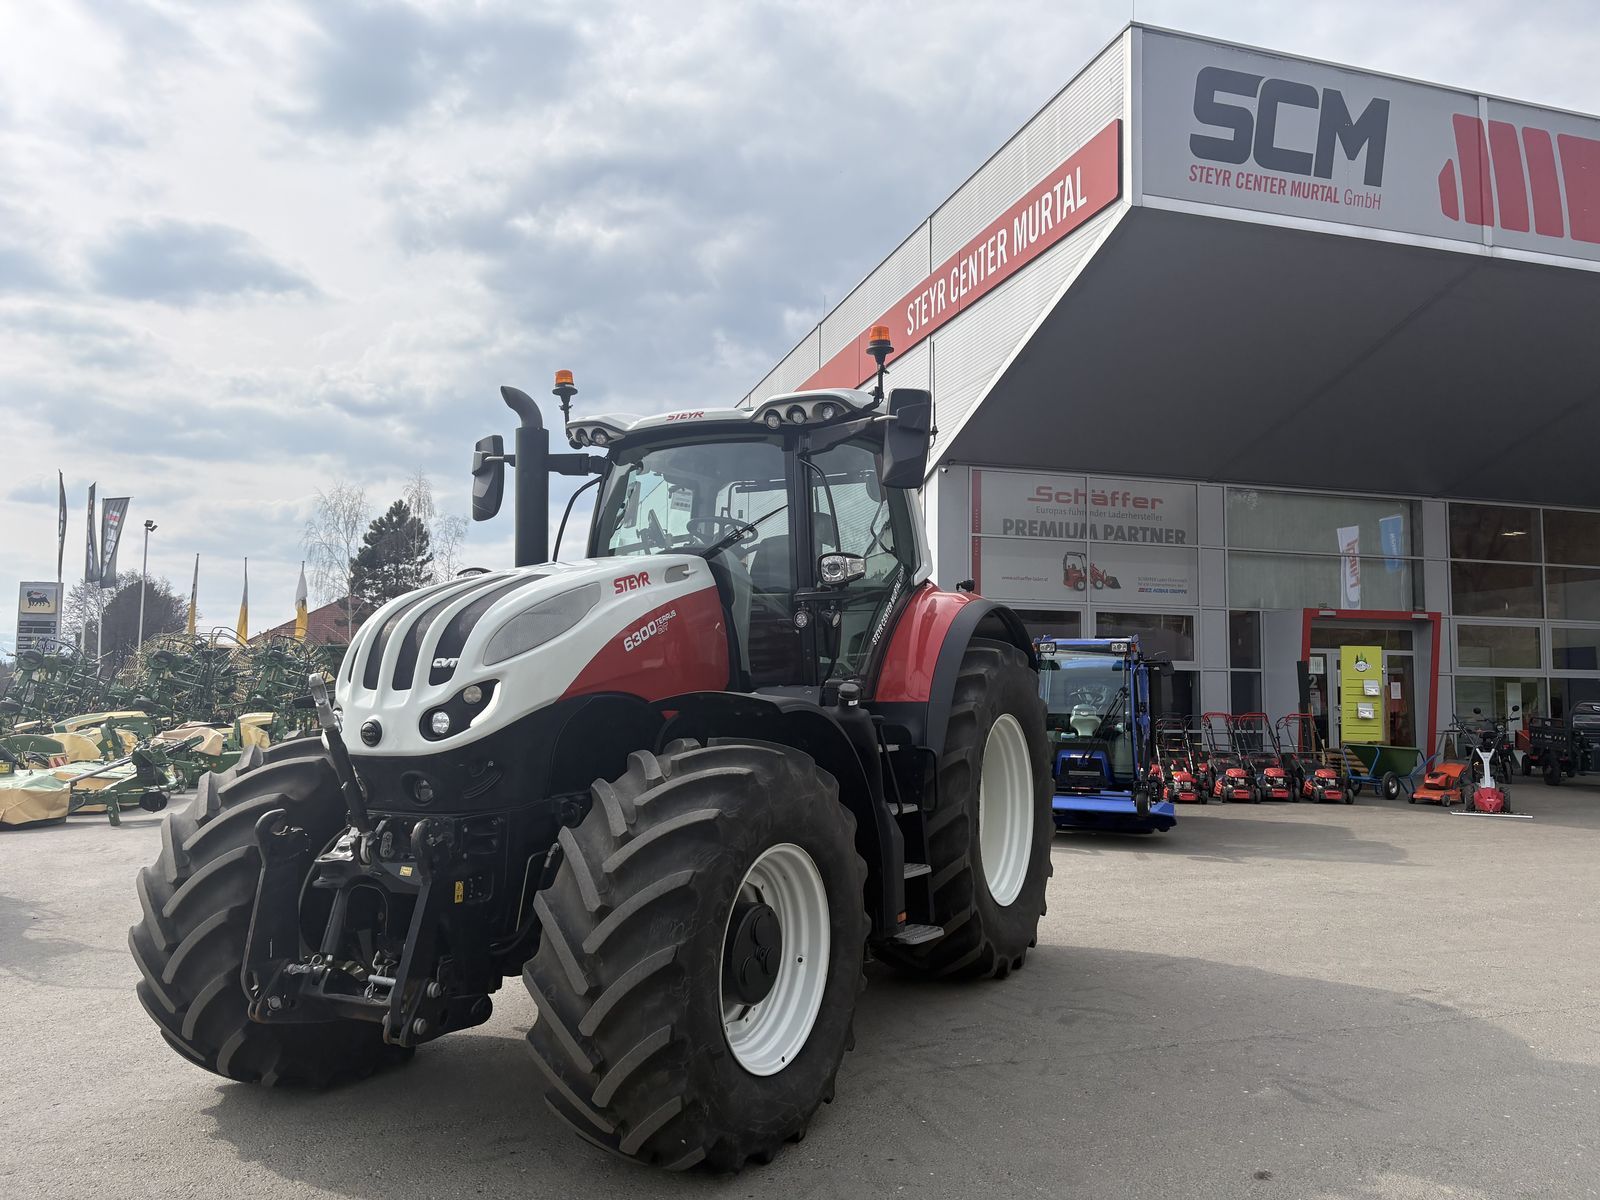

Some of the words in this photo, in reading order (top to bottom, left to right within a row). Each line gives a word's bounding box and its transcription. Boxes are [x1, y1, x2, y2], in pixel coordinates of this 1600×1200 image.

[1189, 66, 1390, 187] SCM
[1188, 164, 1232, 187] STEYR
[1235, 171, 1286, 195] CENTER
[1290, 180, 1341, 204] MURTAL
[1343, 188, 1382, 210] GmbH
[906, 278, 946, 336] STEYR
[950, 228, 1008, 304] CENTER
[1012, 166, 1088, 257] MURTAL
[666, 411, 705, 422] STEYR
[1027, 485, 1164, 510] Schäffer
[1003, 518, 1098, 540] PREMIUM
[1103, 524, 1186, 545] PARTNER
[613, 571, 651, 595] STEYR
[623, 620, 657, 652] 6300
[655, 609, 677, 626] TERRUS
[871, 625, 884, 646] STEYR
[881, 601, 894, 627] CENTER
[433, 657, 459, 668] CVT
